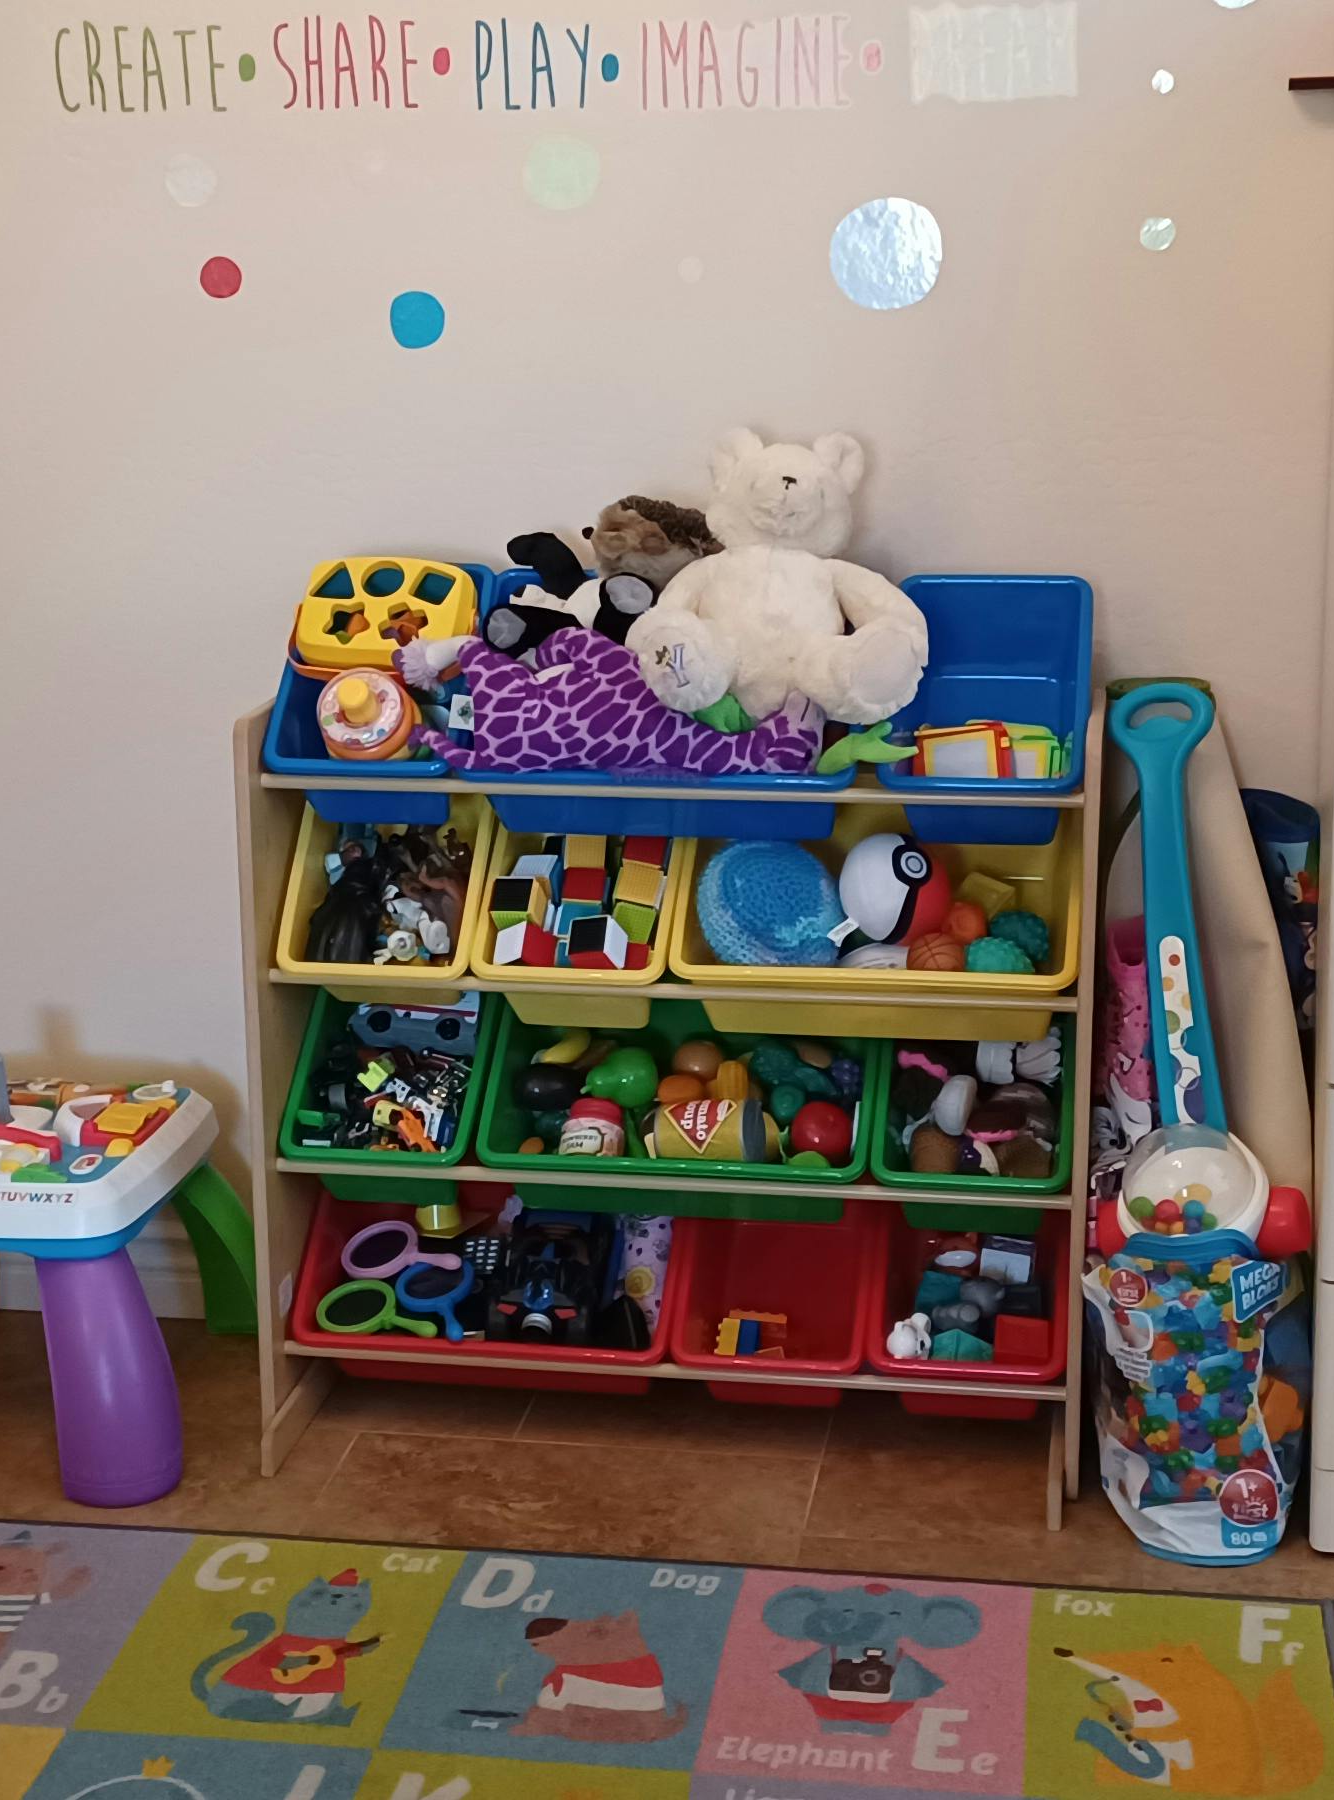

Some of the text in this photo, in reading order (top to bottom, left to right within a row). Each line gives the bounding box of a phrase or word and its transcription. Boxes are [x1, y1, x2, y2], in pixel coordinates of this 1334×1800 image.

[54, 21, 227, 112] CREATE
[273, 15, 418, 110] SHARE
[474, 18, 590, 110] PLAY
[642, 17, 850, 110] IMAGINE
[382, 1553, 442, 1573] Cat
[1230, 1532, 1251, 1546] 80
[193, 1541, 274, 1595] Cc
[461, 1557, 554, 1613] Dd
[649, 1568, 720, 1595] Dog
[1054, 1594, 1114, 1618] Fox
[1237, 1604, 1304, 1666] Ff
[715, 1707, 998, 1775] Elephant Ee
